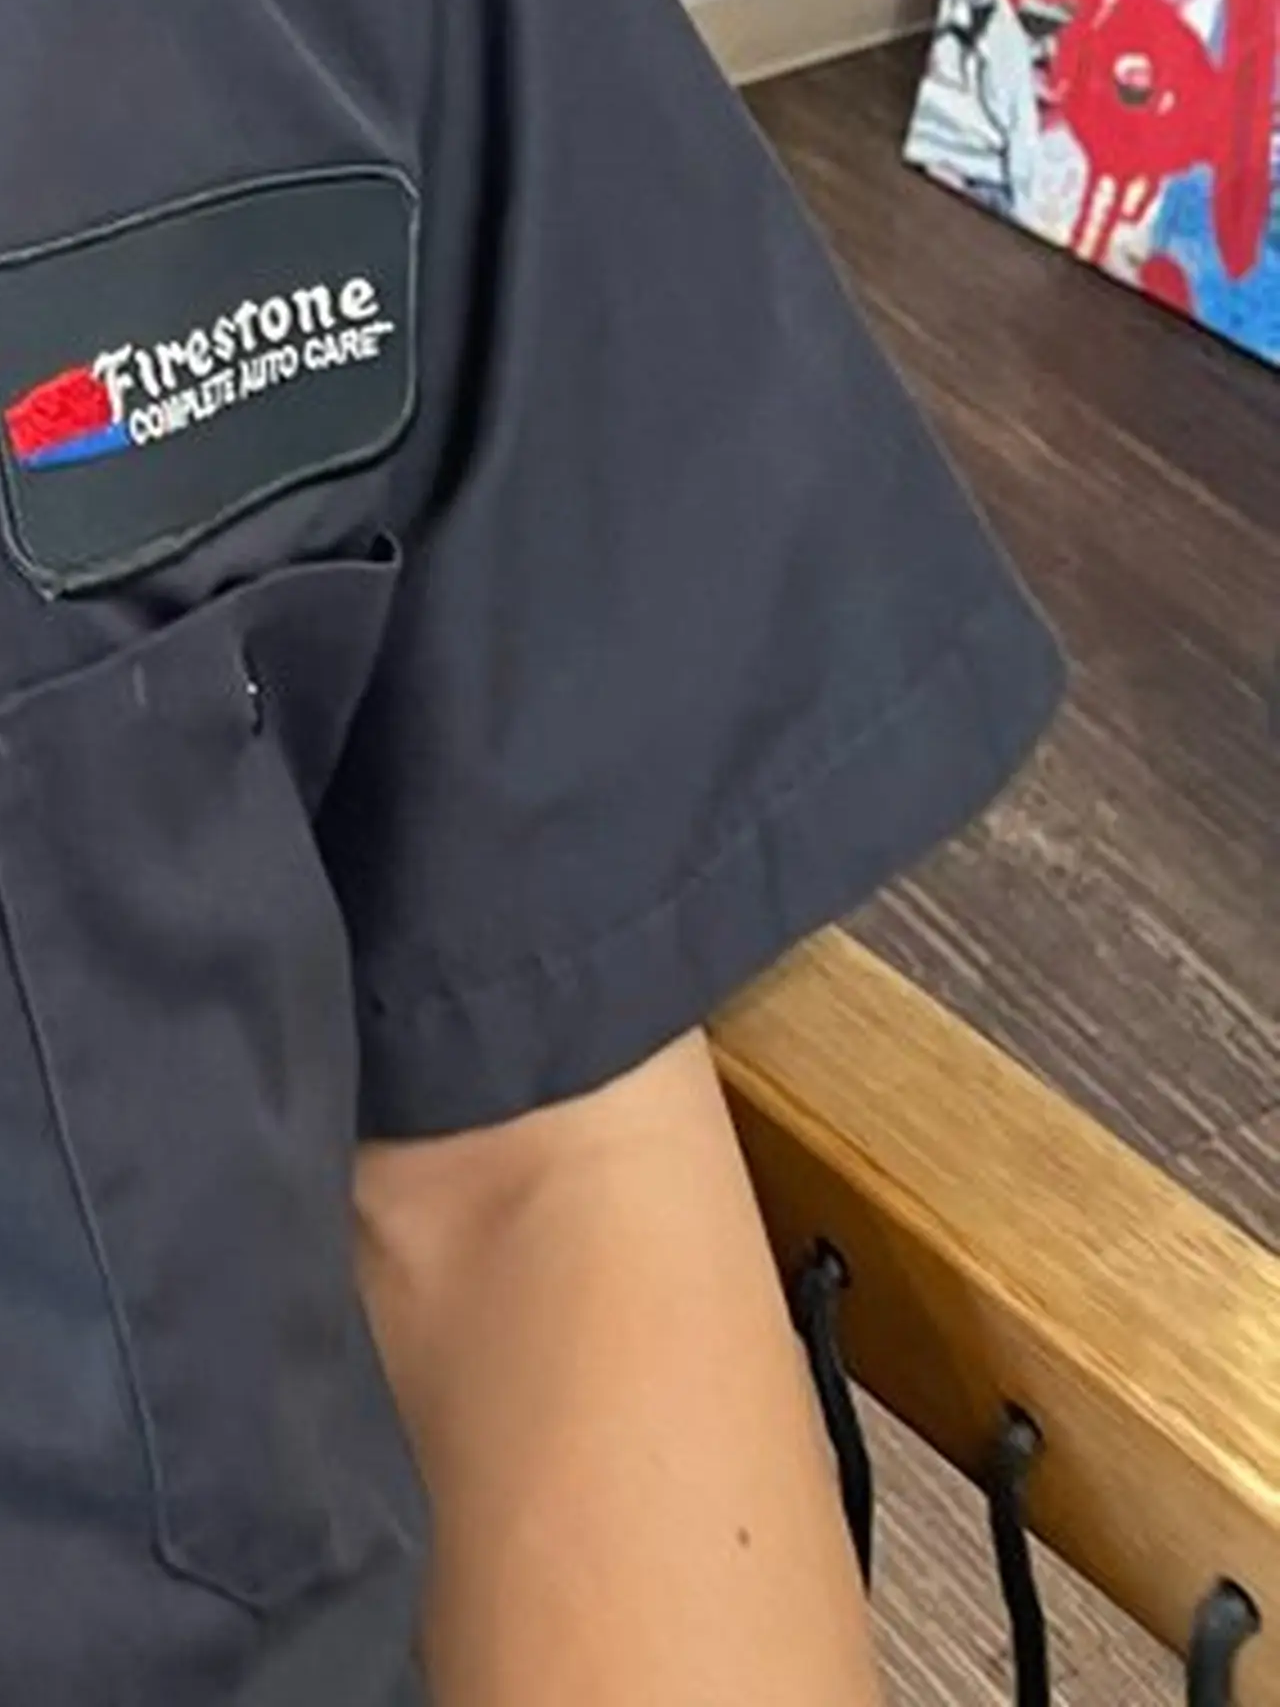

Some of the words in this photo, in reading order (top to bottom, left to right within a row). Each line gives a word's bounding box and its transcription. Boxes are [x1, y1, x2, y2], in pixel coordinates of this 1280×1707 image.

[92, 277, 381, 425] Firestone
[239, 344, 299, 400] AUTO
[303, 326, 382, 371] CARE
